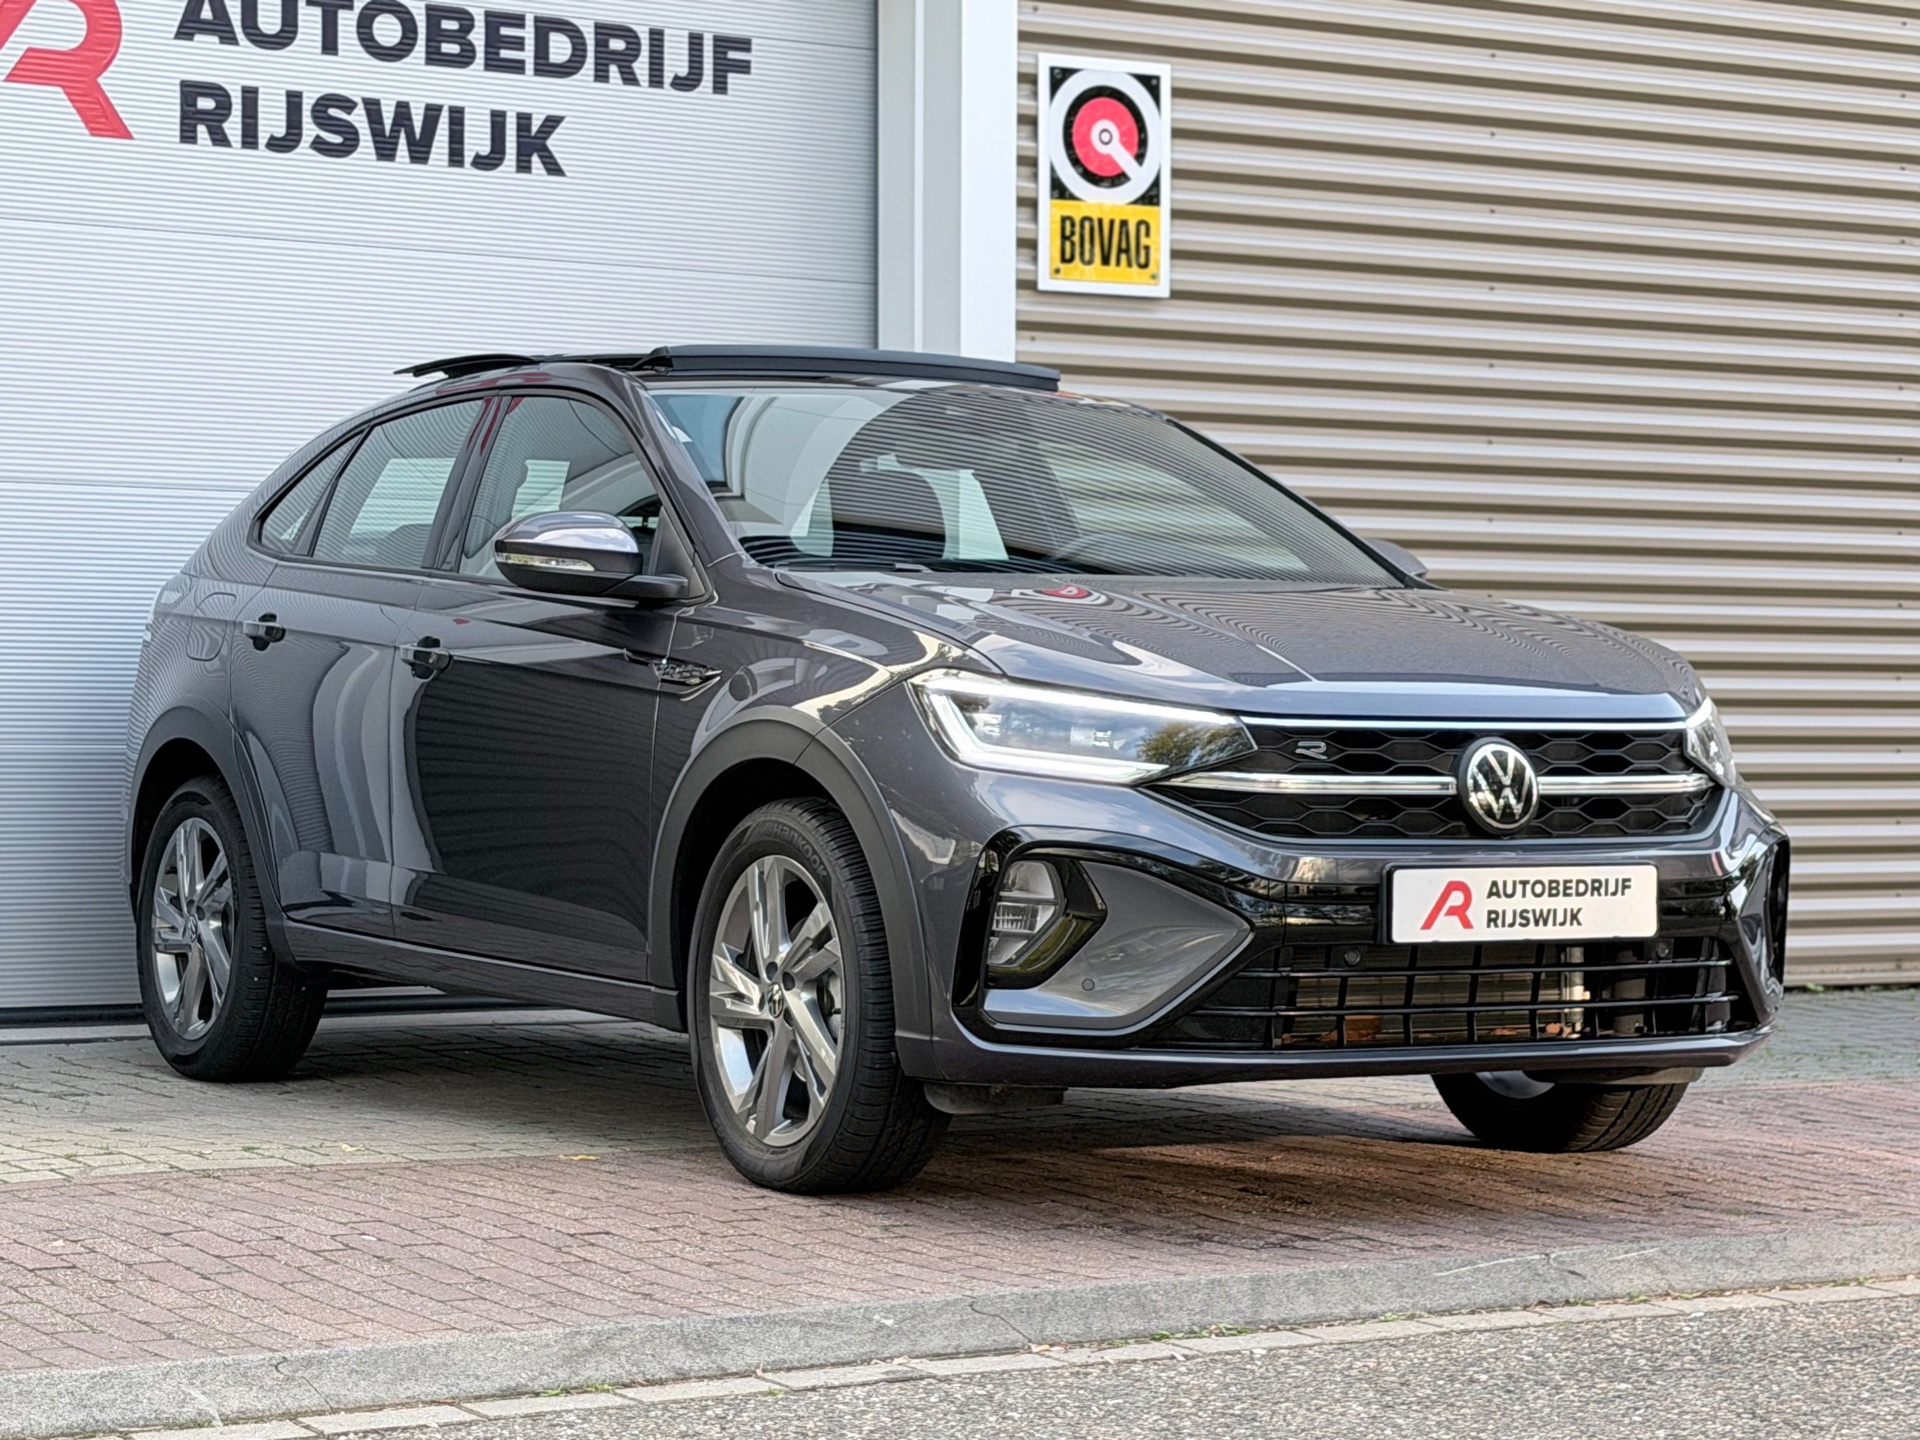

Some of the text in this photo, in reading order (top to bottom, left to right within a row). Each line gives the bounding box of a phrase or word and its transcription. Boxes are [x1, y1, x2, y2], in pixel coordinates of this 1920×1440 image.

[174, 0, 752, 95] AUTOBEDRIJF
[179, 80, 566, 177] RIJSWIJK
[1060, 215, 1151, 270] BOVAG
[1485, 878, 1632, 899] AUTOBEDRIJF
[1486, 908, 1583, 929] RIJSWIJK
